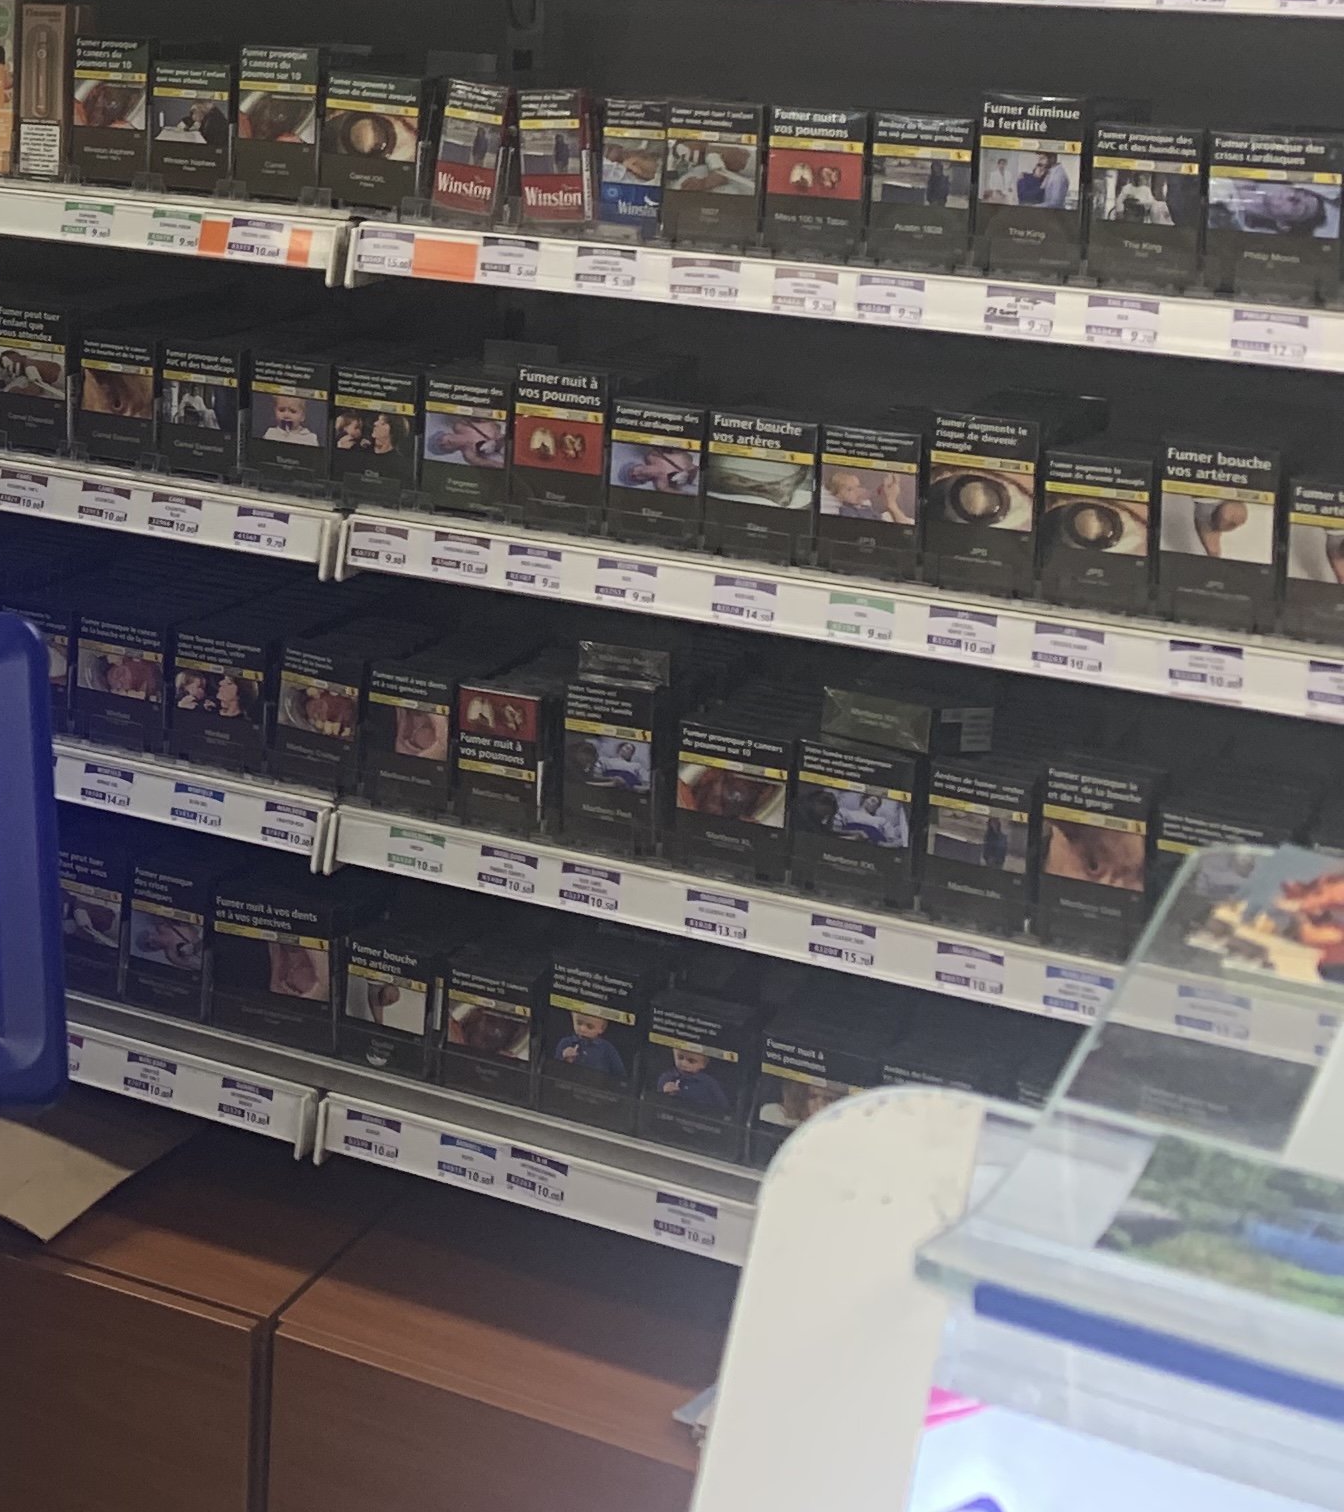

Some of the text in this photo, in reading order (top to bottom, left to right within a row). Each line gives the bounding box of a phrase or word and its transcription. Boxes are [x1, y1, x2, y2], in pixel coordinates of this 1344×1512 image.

[76, 37, 100, 49] Fumer
[84, 49, 110, 60] cancers
[76, 59, 132, 70] poumon 10
[774, 108, 811, 125] Fumer
[983, 101, 1081, 120] Fumer diminue
[794, 123, 849, 139] poumons
[982, 116, 1048, 133] la fertilité
[437, 170, 492, 201] Winston
[524, 186, 582, 207] Winston
[519, 369, 599, 390] Fumer nuit à
[518, 386, 601, 407] vos poumons
[714, 414, 803, 437] Fumer bouche
[712, 433, 782, 450] vos artères
[1167, 446, 1272, 472] Fumer bouche
[1167, 464, 1249, 485] vos artères
[459, 731, 515, 750] Fumer nuit
[479, 745, 525, 767] poumons
[216, 895, 248, 911] Fumer
